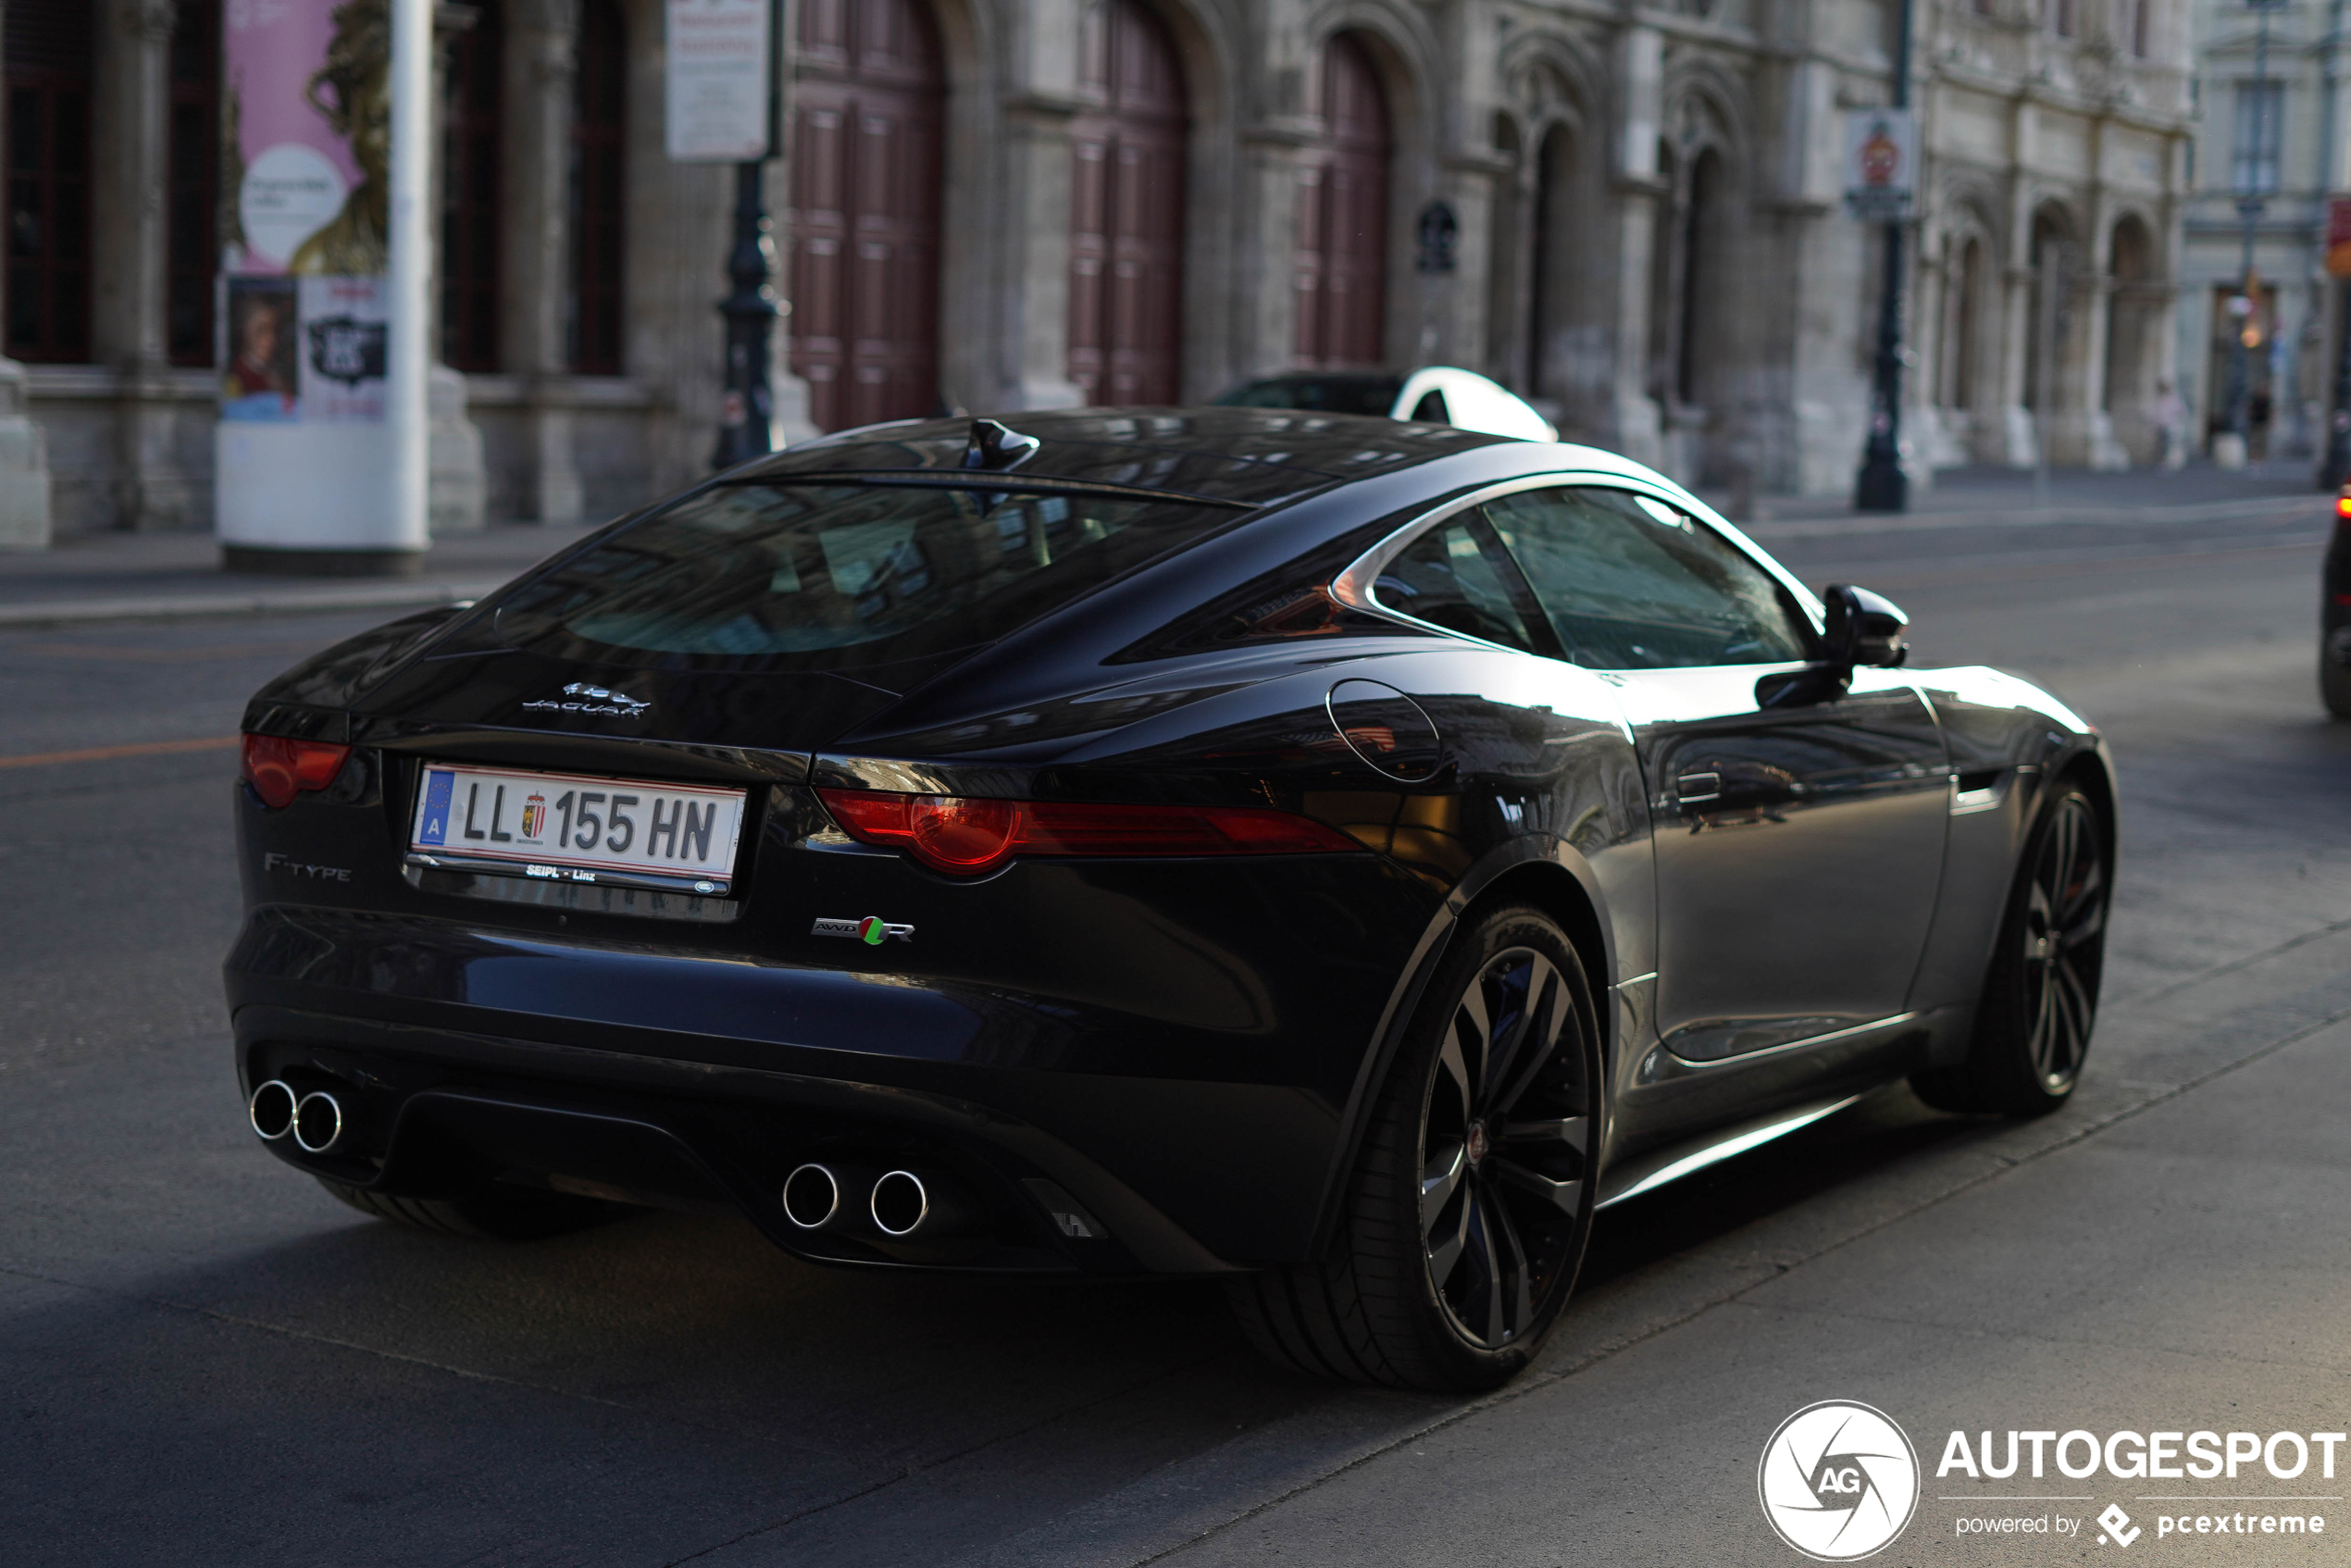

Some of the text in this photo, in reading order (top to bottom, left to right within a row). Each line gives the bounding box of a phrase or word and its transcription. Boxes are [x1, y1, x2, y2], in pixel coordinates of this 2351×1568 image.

[522, 700, 644, 718] JAGUAR
[428, 818, 441, 836] A
[464, 783, 716, 861] LL 155 HN
[265, 852, 353, 882] F-TYPE
[526, 865, 560, 878] SEIPL
[572, 869, 596, 882] Linz
[815, 924, 856, 932] AWD
